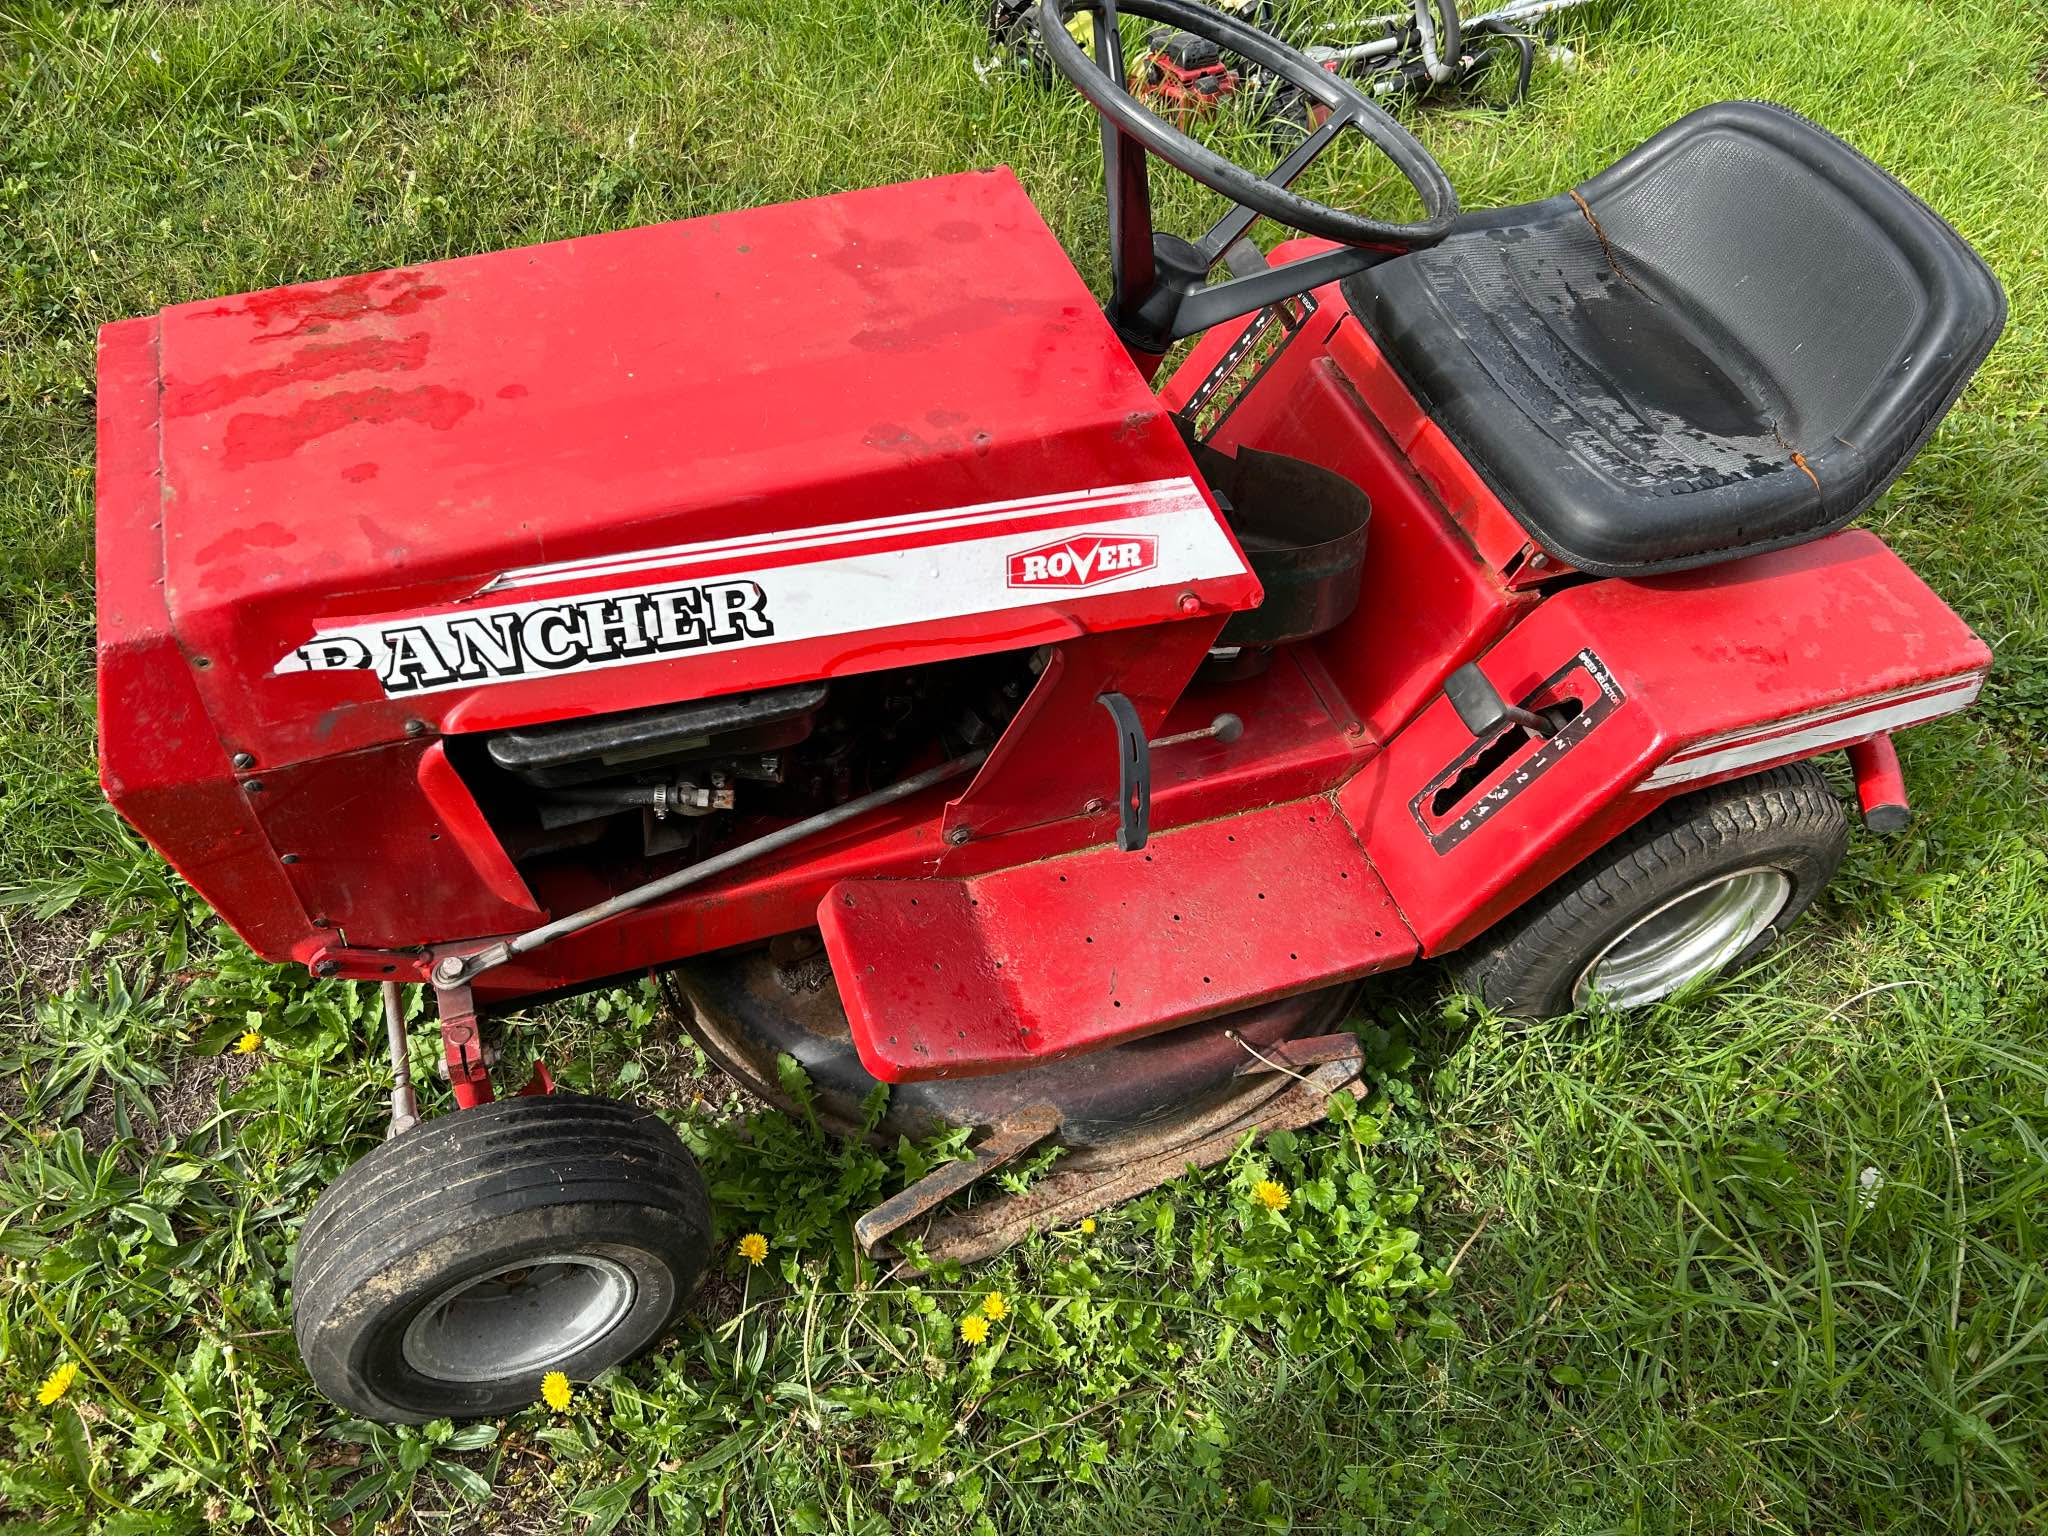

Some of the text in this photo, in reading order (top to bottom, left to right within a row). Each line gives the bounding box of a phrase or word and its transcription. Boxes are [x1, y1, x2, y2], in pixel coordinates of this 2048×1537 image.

[1256, 316, 1265, 327] 2
[1023, 538, 1142, 584] ROVER
[1578, 652, 1620, 705] SPEED SELECTOR
[1582, 717, 1592, 728] R
[1556, 739, 1566, 750] N
[1536, 757, 1547, 767] 1
[1516, 773, 1529, 784] 2
[1497, 788, 1509, 800] 3
[1478, 804, 1490, 815] 4
[1460, 819, 1471, 831] 5
